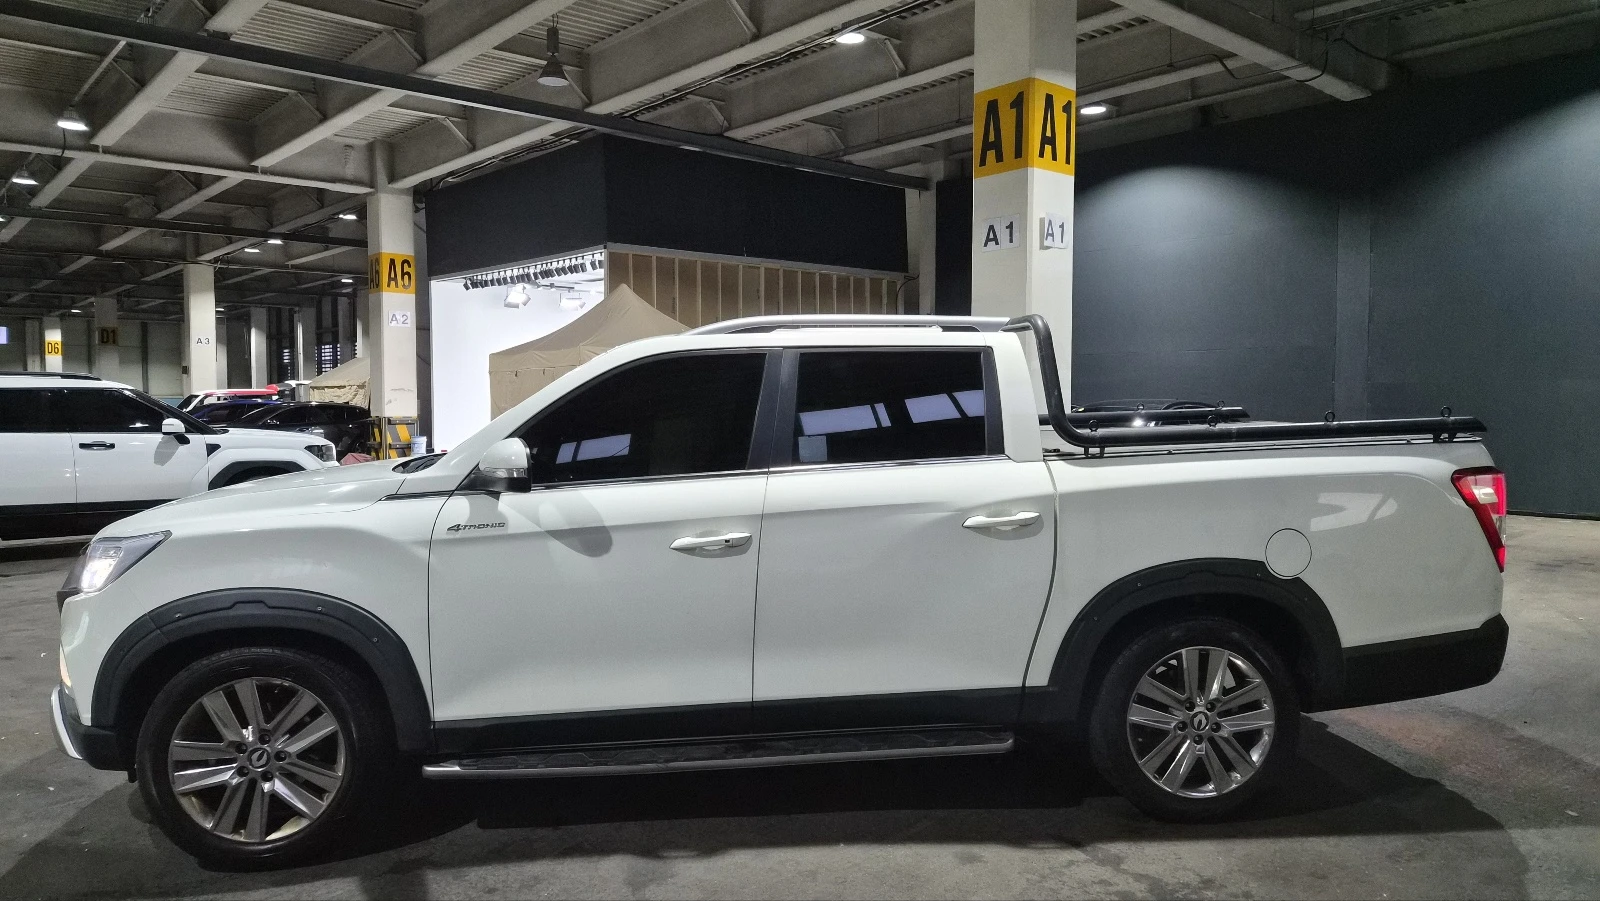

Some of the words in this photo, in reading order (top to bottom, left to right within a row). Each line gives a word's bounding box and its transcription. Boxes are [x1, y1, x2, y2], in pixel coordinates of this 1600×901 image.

[978, 91, 1025, 167] A1
[1038, 92, 1072, 165] A1
[369, 257, 380, 290] A6
[386, 257, 412, 290] A6
[47, 342, 60, 354] D6
[100, 328, 116, 344] D1
